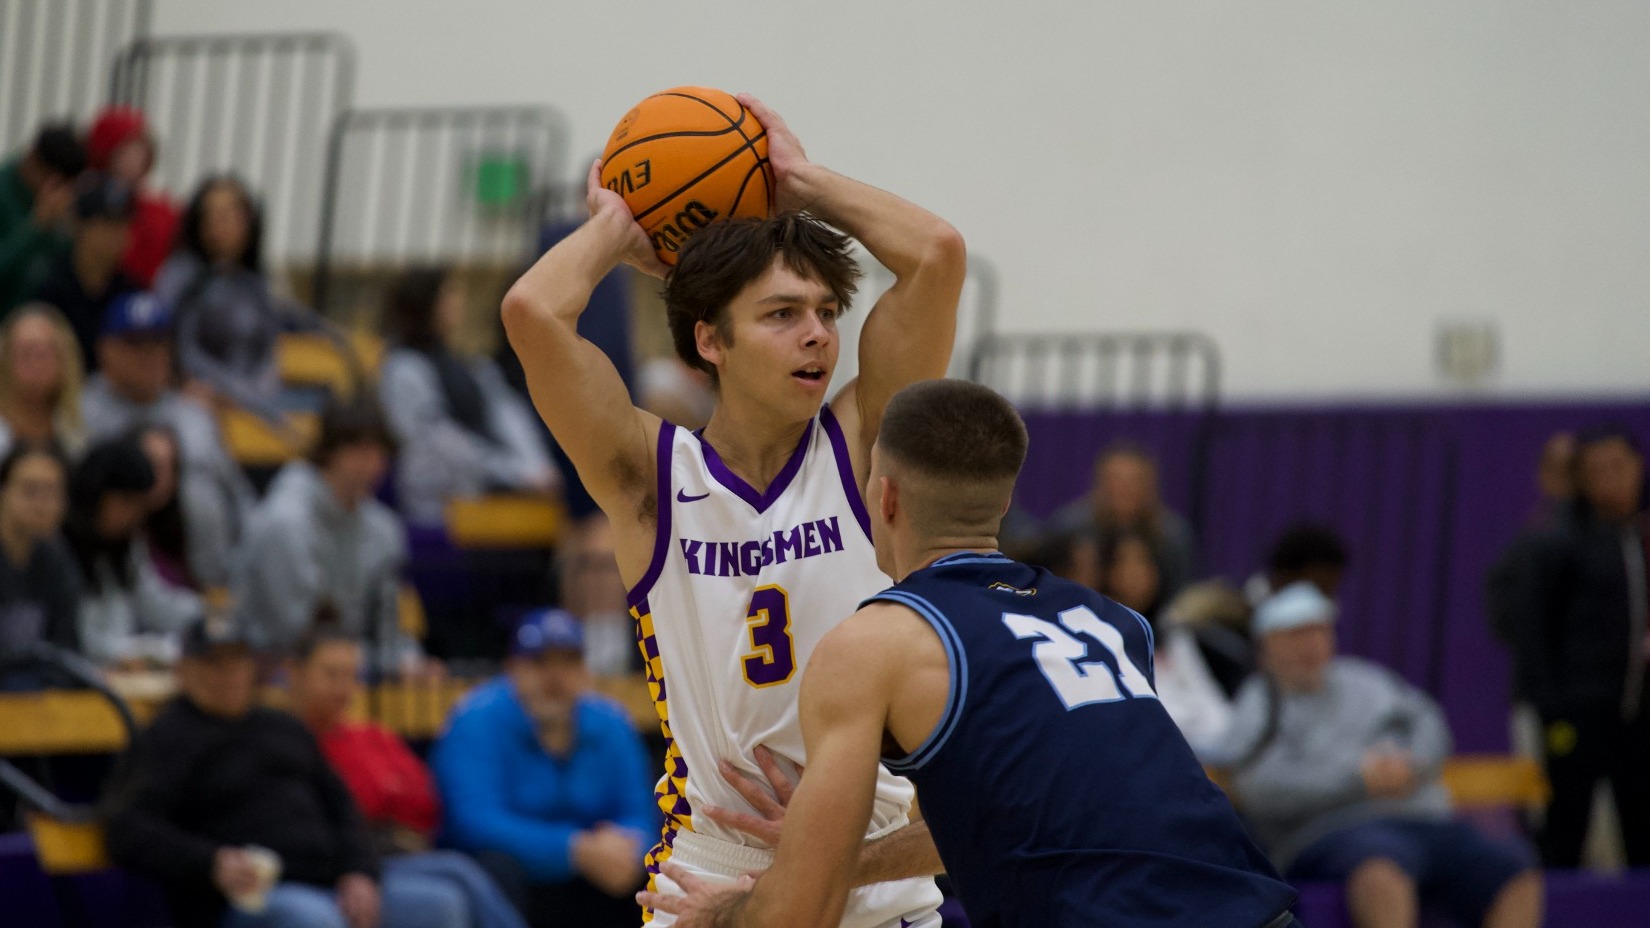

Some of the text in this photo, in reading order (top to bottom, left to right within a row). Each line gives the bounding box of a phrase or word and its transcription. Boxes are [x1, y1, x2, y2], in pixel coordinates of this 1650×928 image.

[680, 516, 845, 577] KINGSMEN
[741, 583, 797, 689] 3
[1001, 604, 1159, 712] 21
